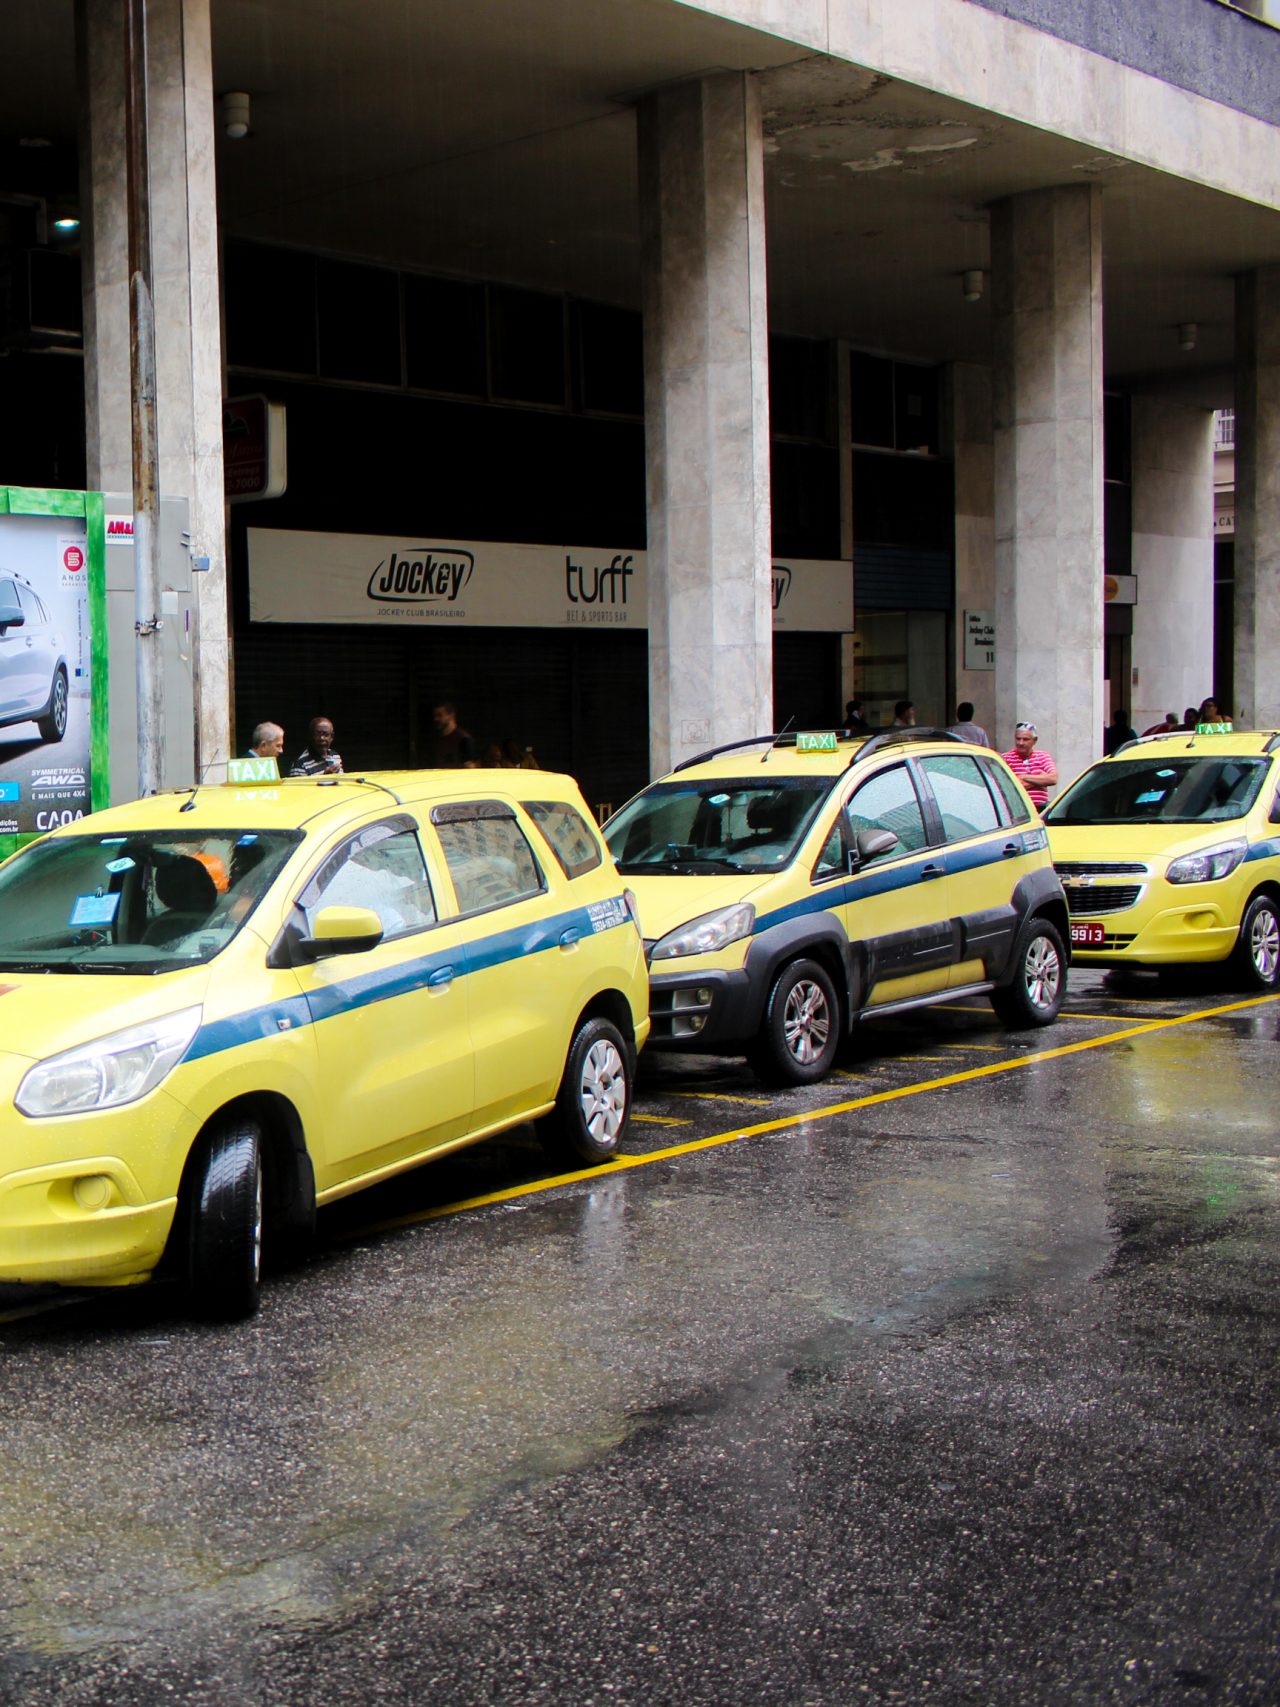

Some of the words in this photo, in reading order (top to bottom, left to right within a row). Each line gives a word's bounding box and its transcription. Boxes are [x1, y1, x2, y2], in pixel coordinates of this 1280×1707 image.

[378, 553, 466, 601] Jockey
[377, 608, 405, 617] JOCKEY
[406, 609, 424, 618] CLUB
[425, 609, 466, 618] BRASILEIRO
[566, 609, 579, 622] BET
[588, 610, 613, 623] SPORTS
[614, 610, 628, 623] BAR
[1199, 722, 1233, 735] TAXI
[799, 734, 835, 749] TAXI
[31, 767, 86, 777] SYMMETRICAL
[228, 760, 276, 782] TAXI
[31, 774, 86, 786] AWD
[57, 791, 71, 799] QUE
[72, 790, 86, 798] 4X4
